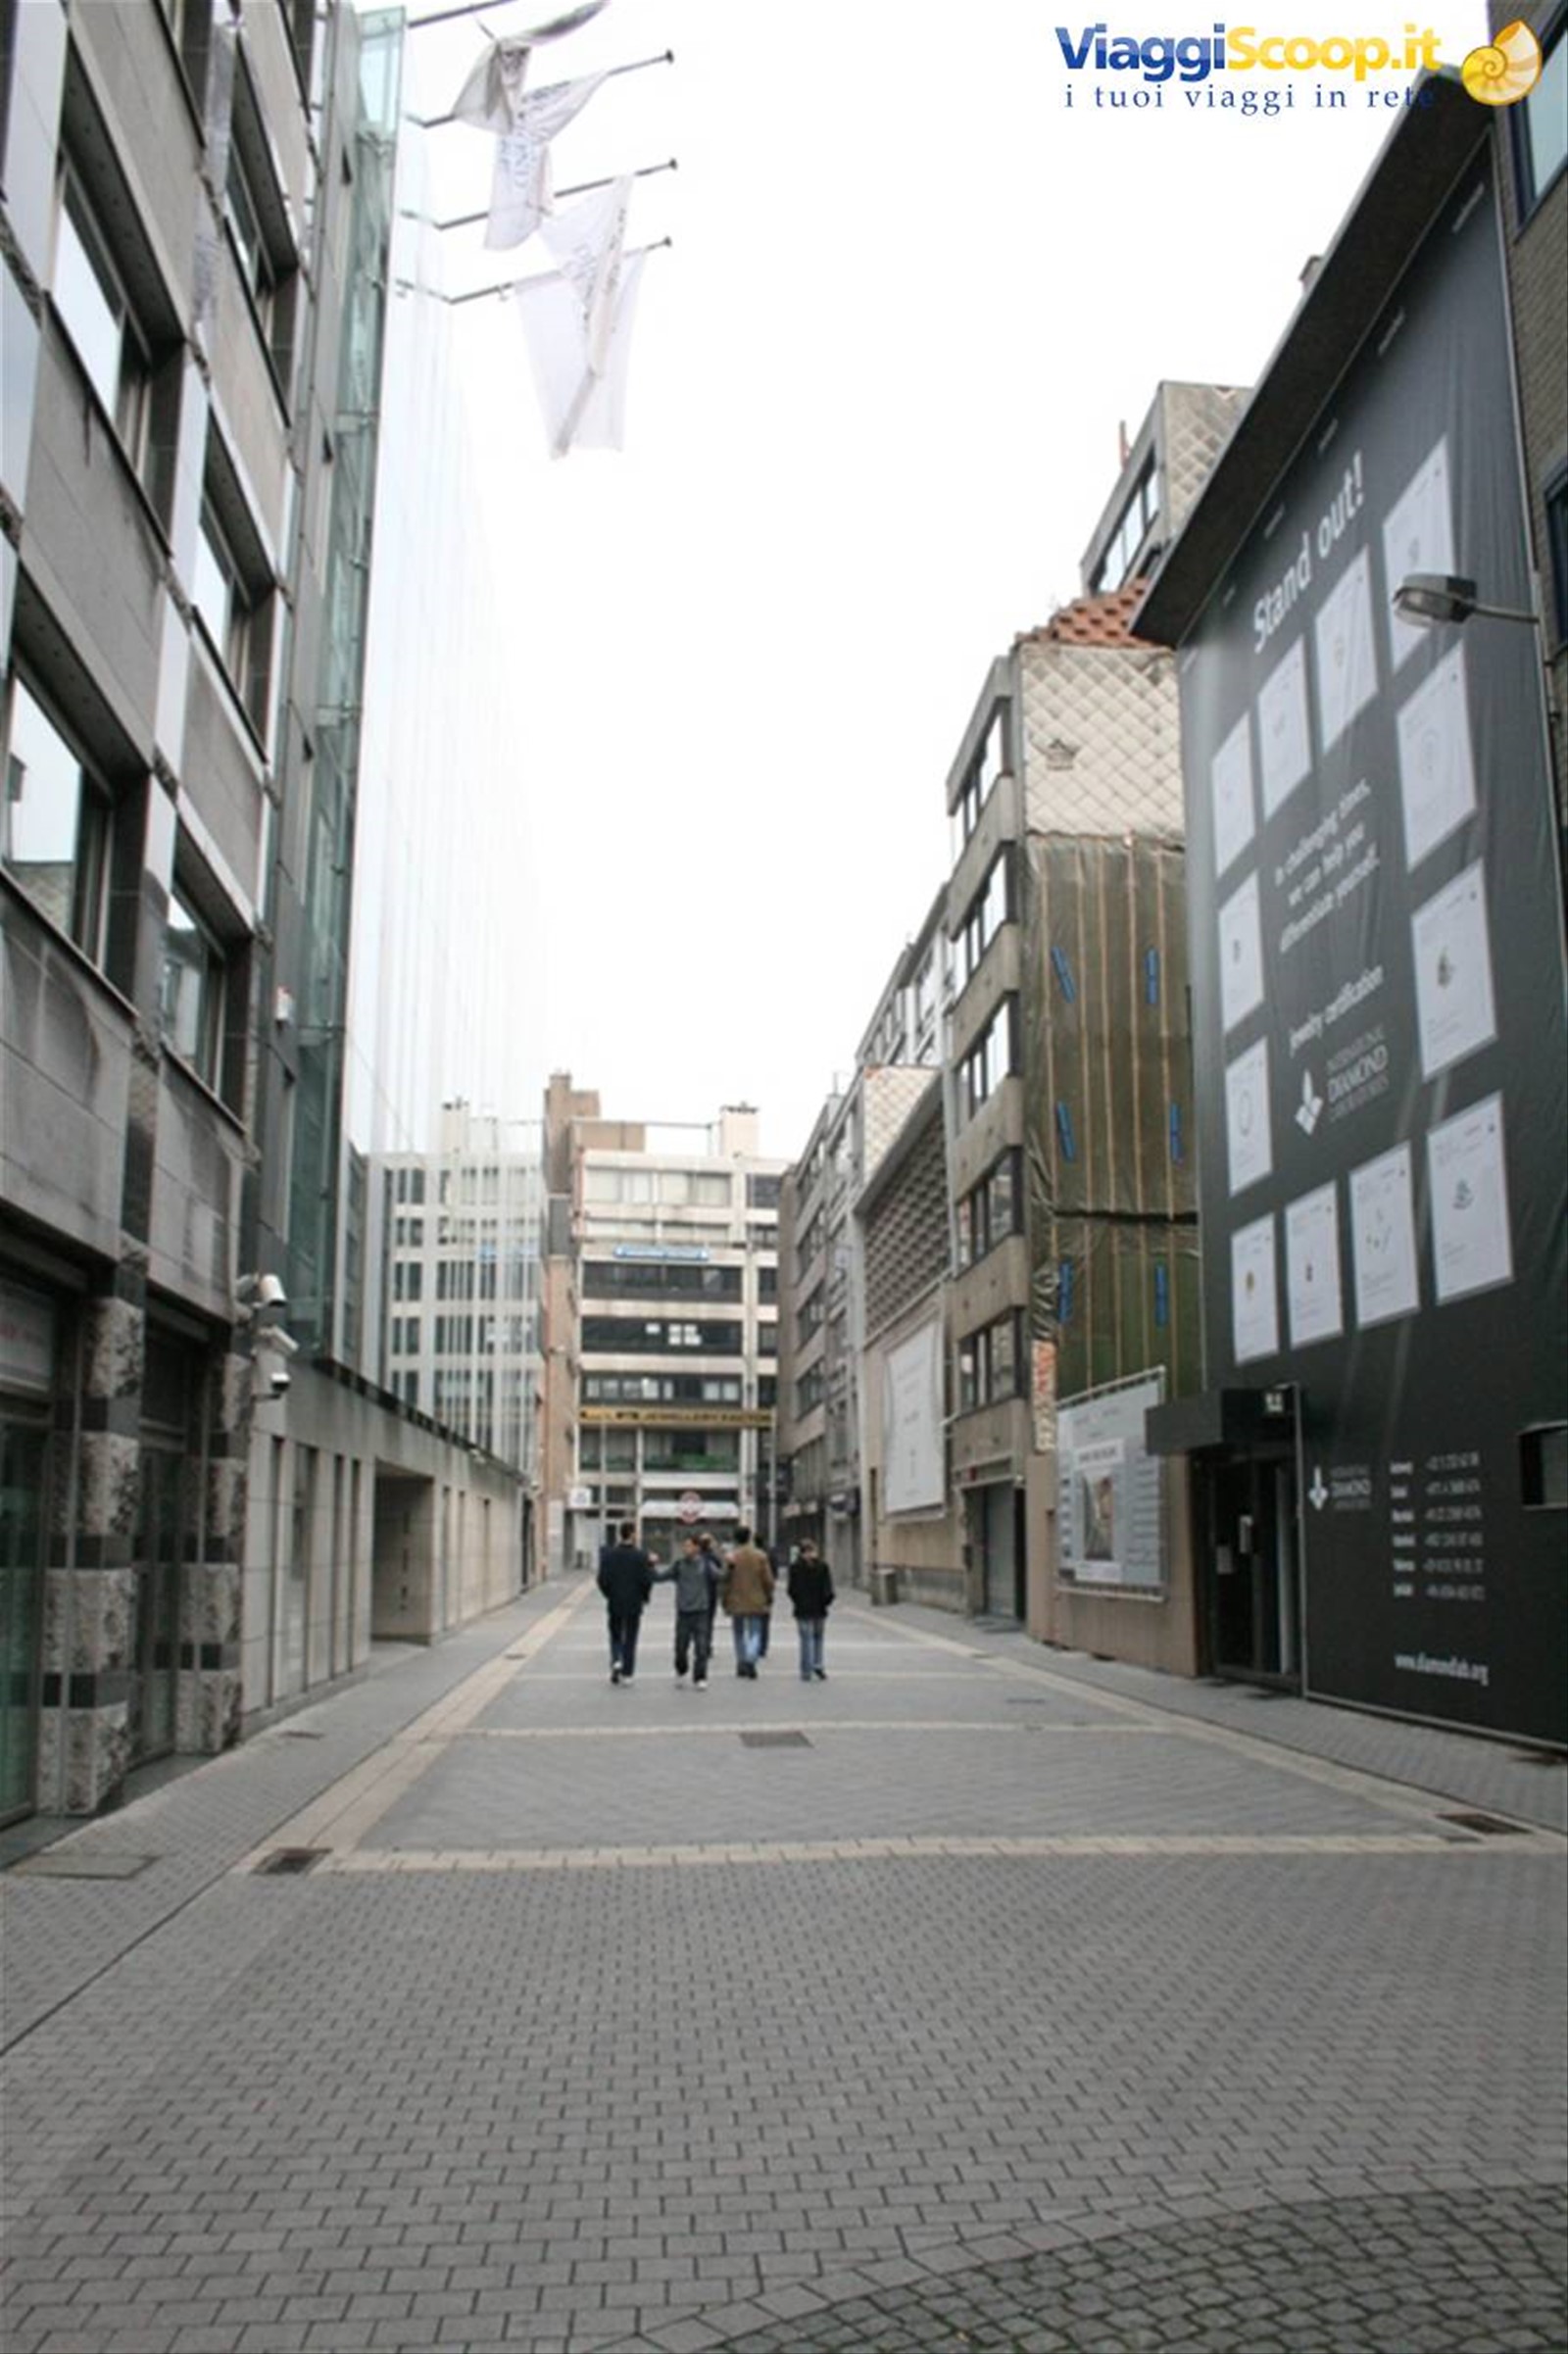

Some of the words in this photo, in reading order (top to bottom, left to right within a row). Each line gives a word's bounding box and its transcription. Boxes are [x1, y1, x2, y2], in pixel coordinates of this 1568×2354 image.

[1253, 531, 1311, 654] Stand
[1317, 450, 1364, 558] out!
[1327, 1044, 1390, 1103] DIAMOND
